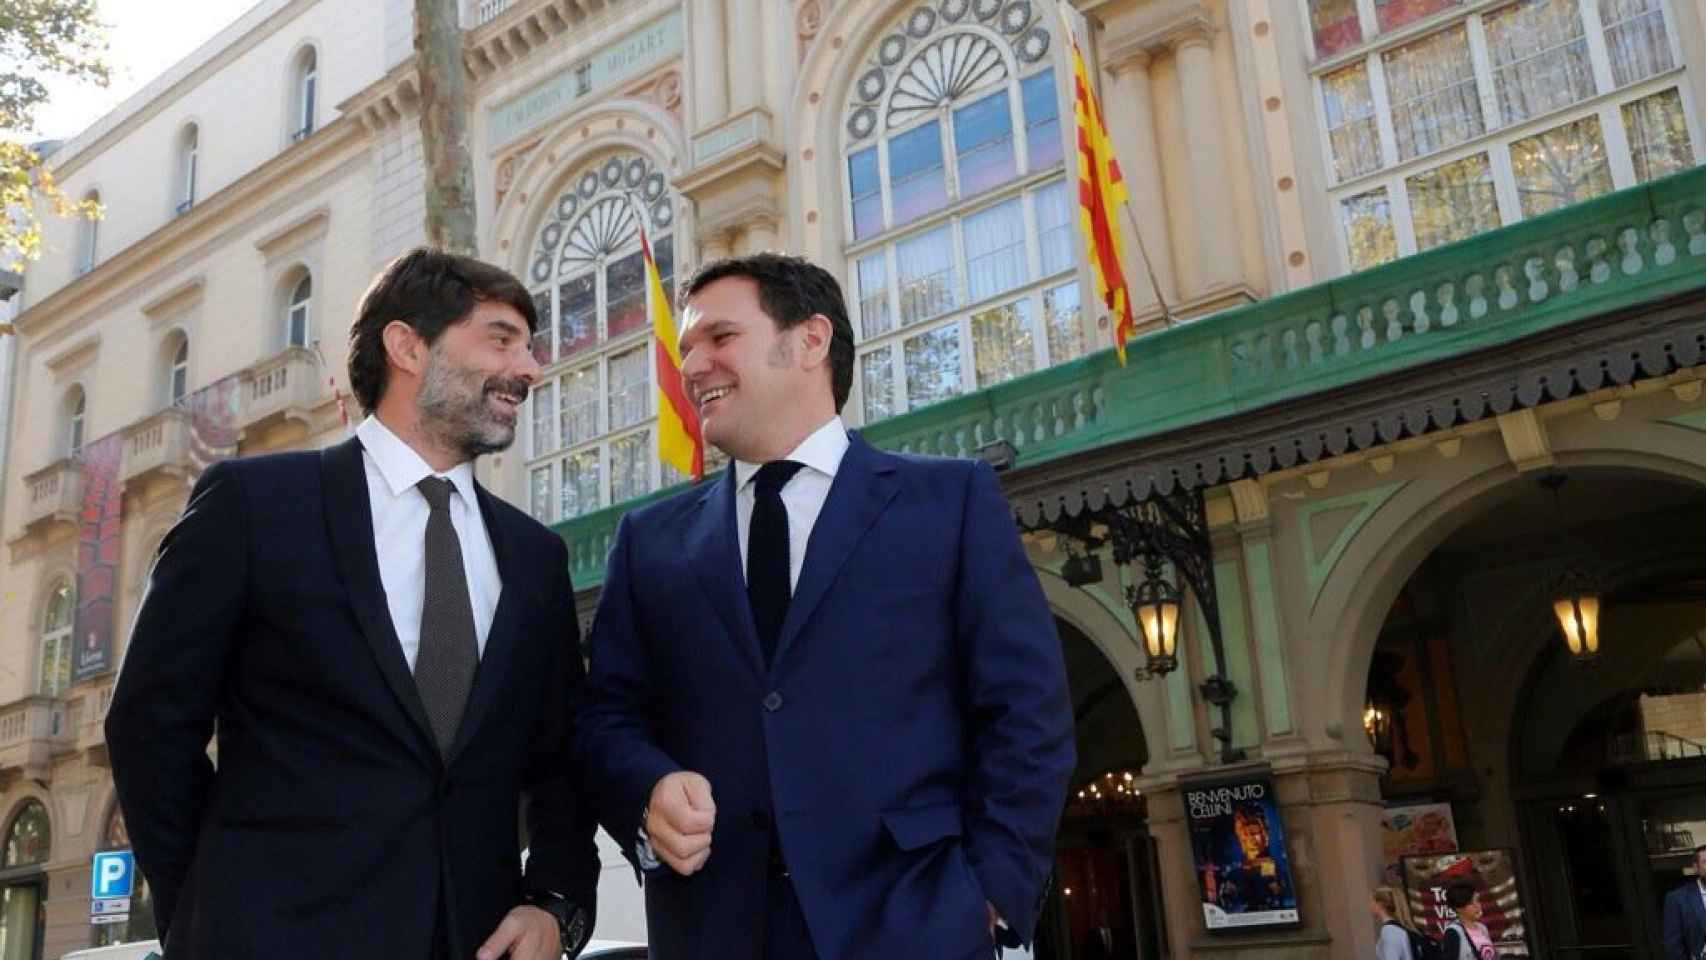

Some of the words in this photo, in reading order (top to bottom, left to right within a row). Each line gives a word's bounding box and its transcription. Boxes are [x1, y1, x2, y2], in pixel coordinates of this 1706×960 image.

[1187, 784, 1264, 805] BENVENUTO
[1190, 801, 1232, 819] CELLINI
[101, 858, 125, 893] P
